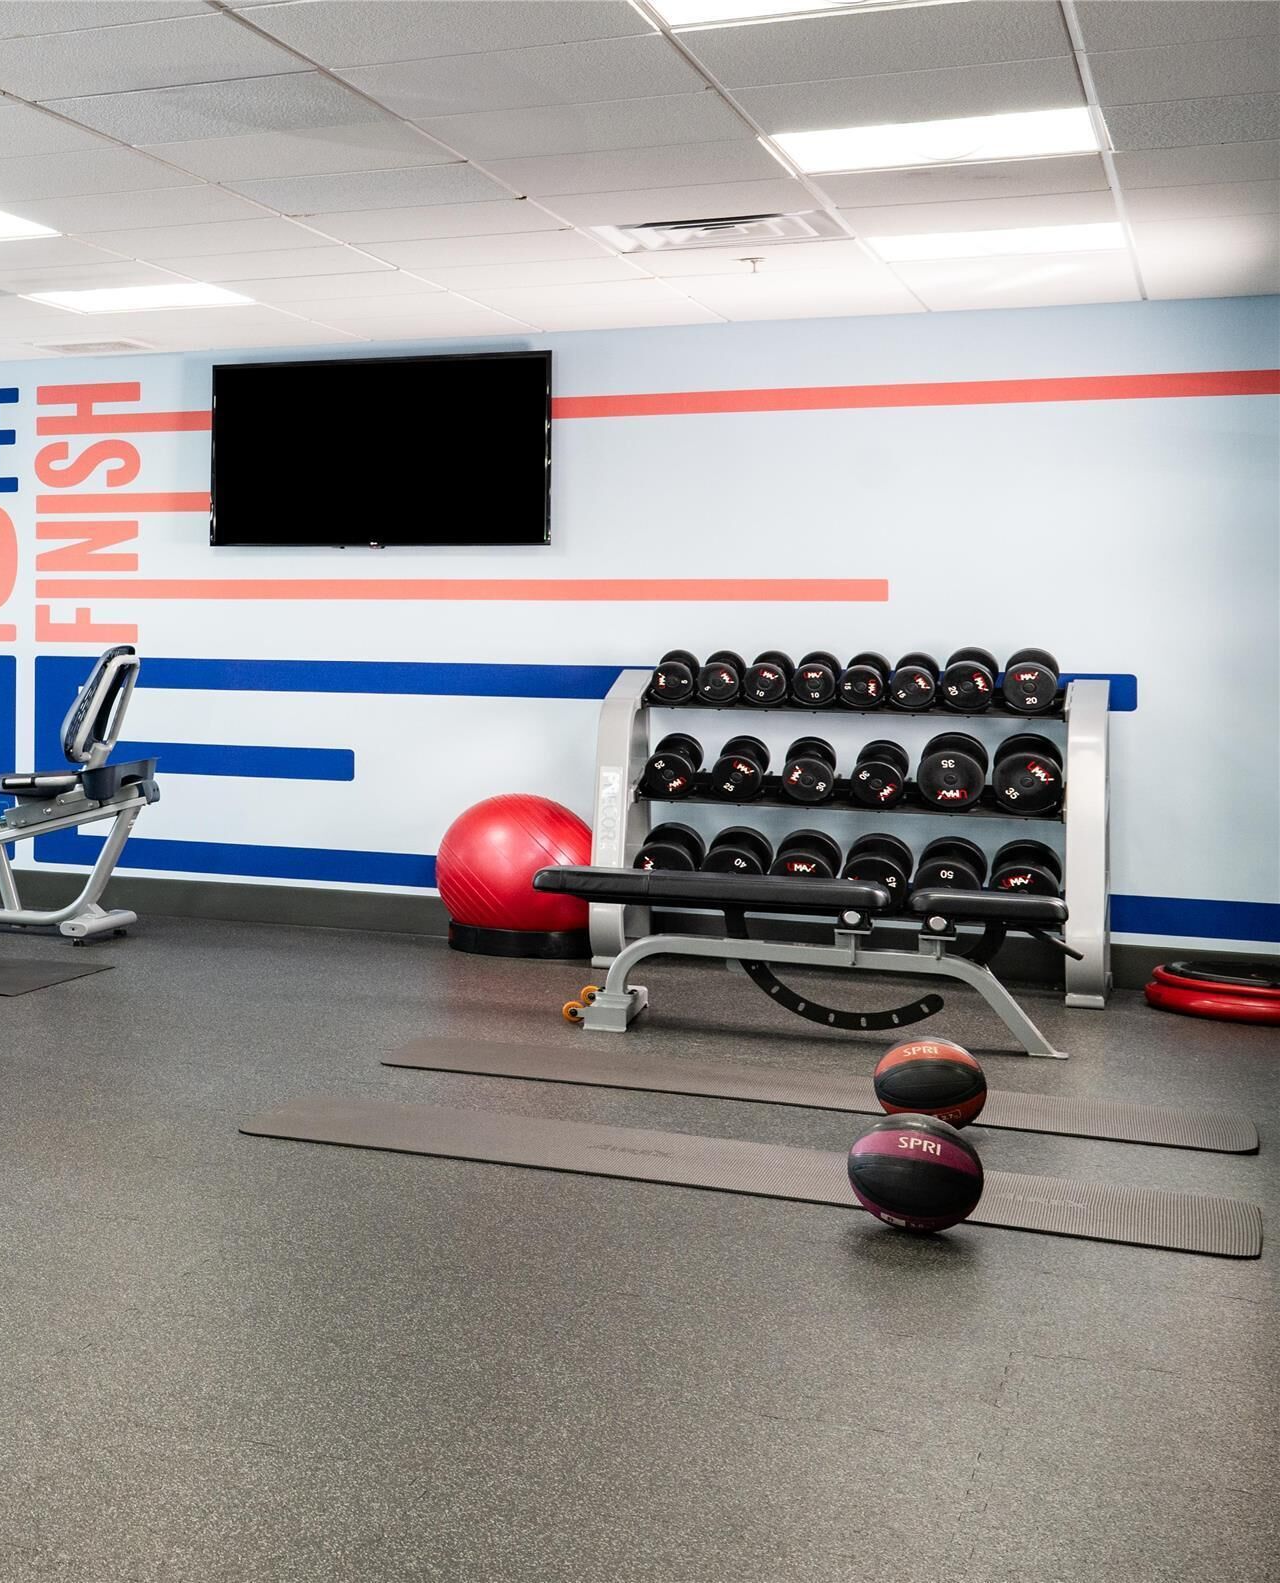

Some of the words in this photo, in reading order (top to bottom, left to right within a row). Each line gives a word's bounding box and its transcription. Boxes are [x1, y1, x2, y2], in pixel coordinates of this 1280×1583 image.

[33, 381, 141, 643] FINISH
[756, 689, 765, 697] 10
[810, 691, 820, 699] 10
[947, 685, 959, 696] 20
[1025, 696, 1038, 705] 20
[654, 759, 666, 770] 25
[941, 759, 956, 769] 35
[858, 770, 871, 781] 30
[722, 782, 735, 793] 25
[815, 781, 828, 792] 30
[1004, 787, 1021, 800] 35
[733, 857, 748, 869] 40
[940, 868, 955, 880] 50
[885, 875, 897, 888] 45
[902, 1045, 939, 1058] SPRI
[897, 1136, 942, 1156] SPRI
